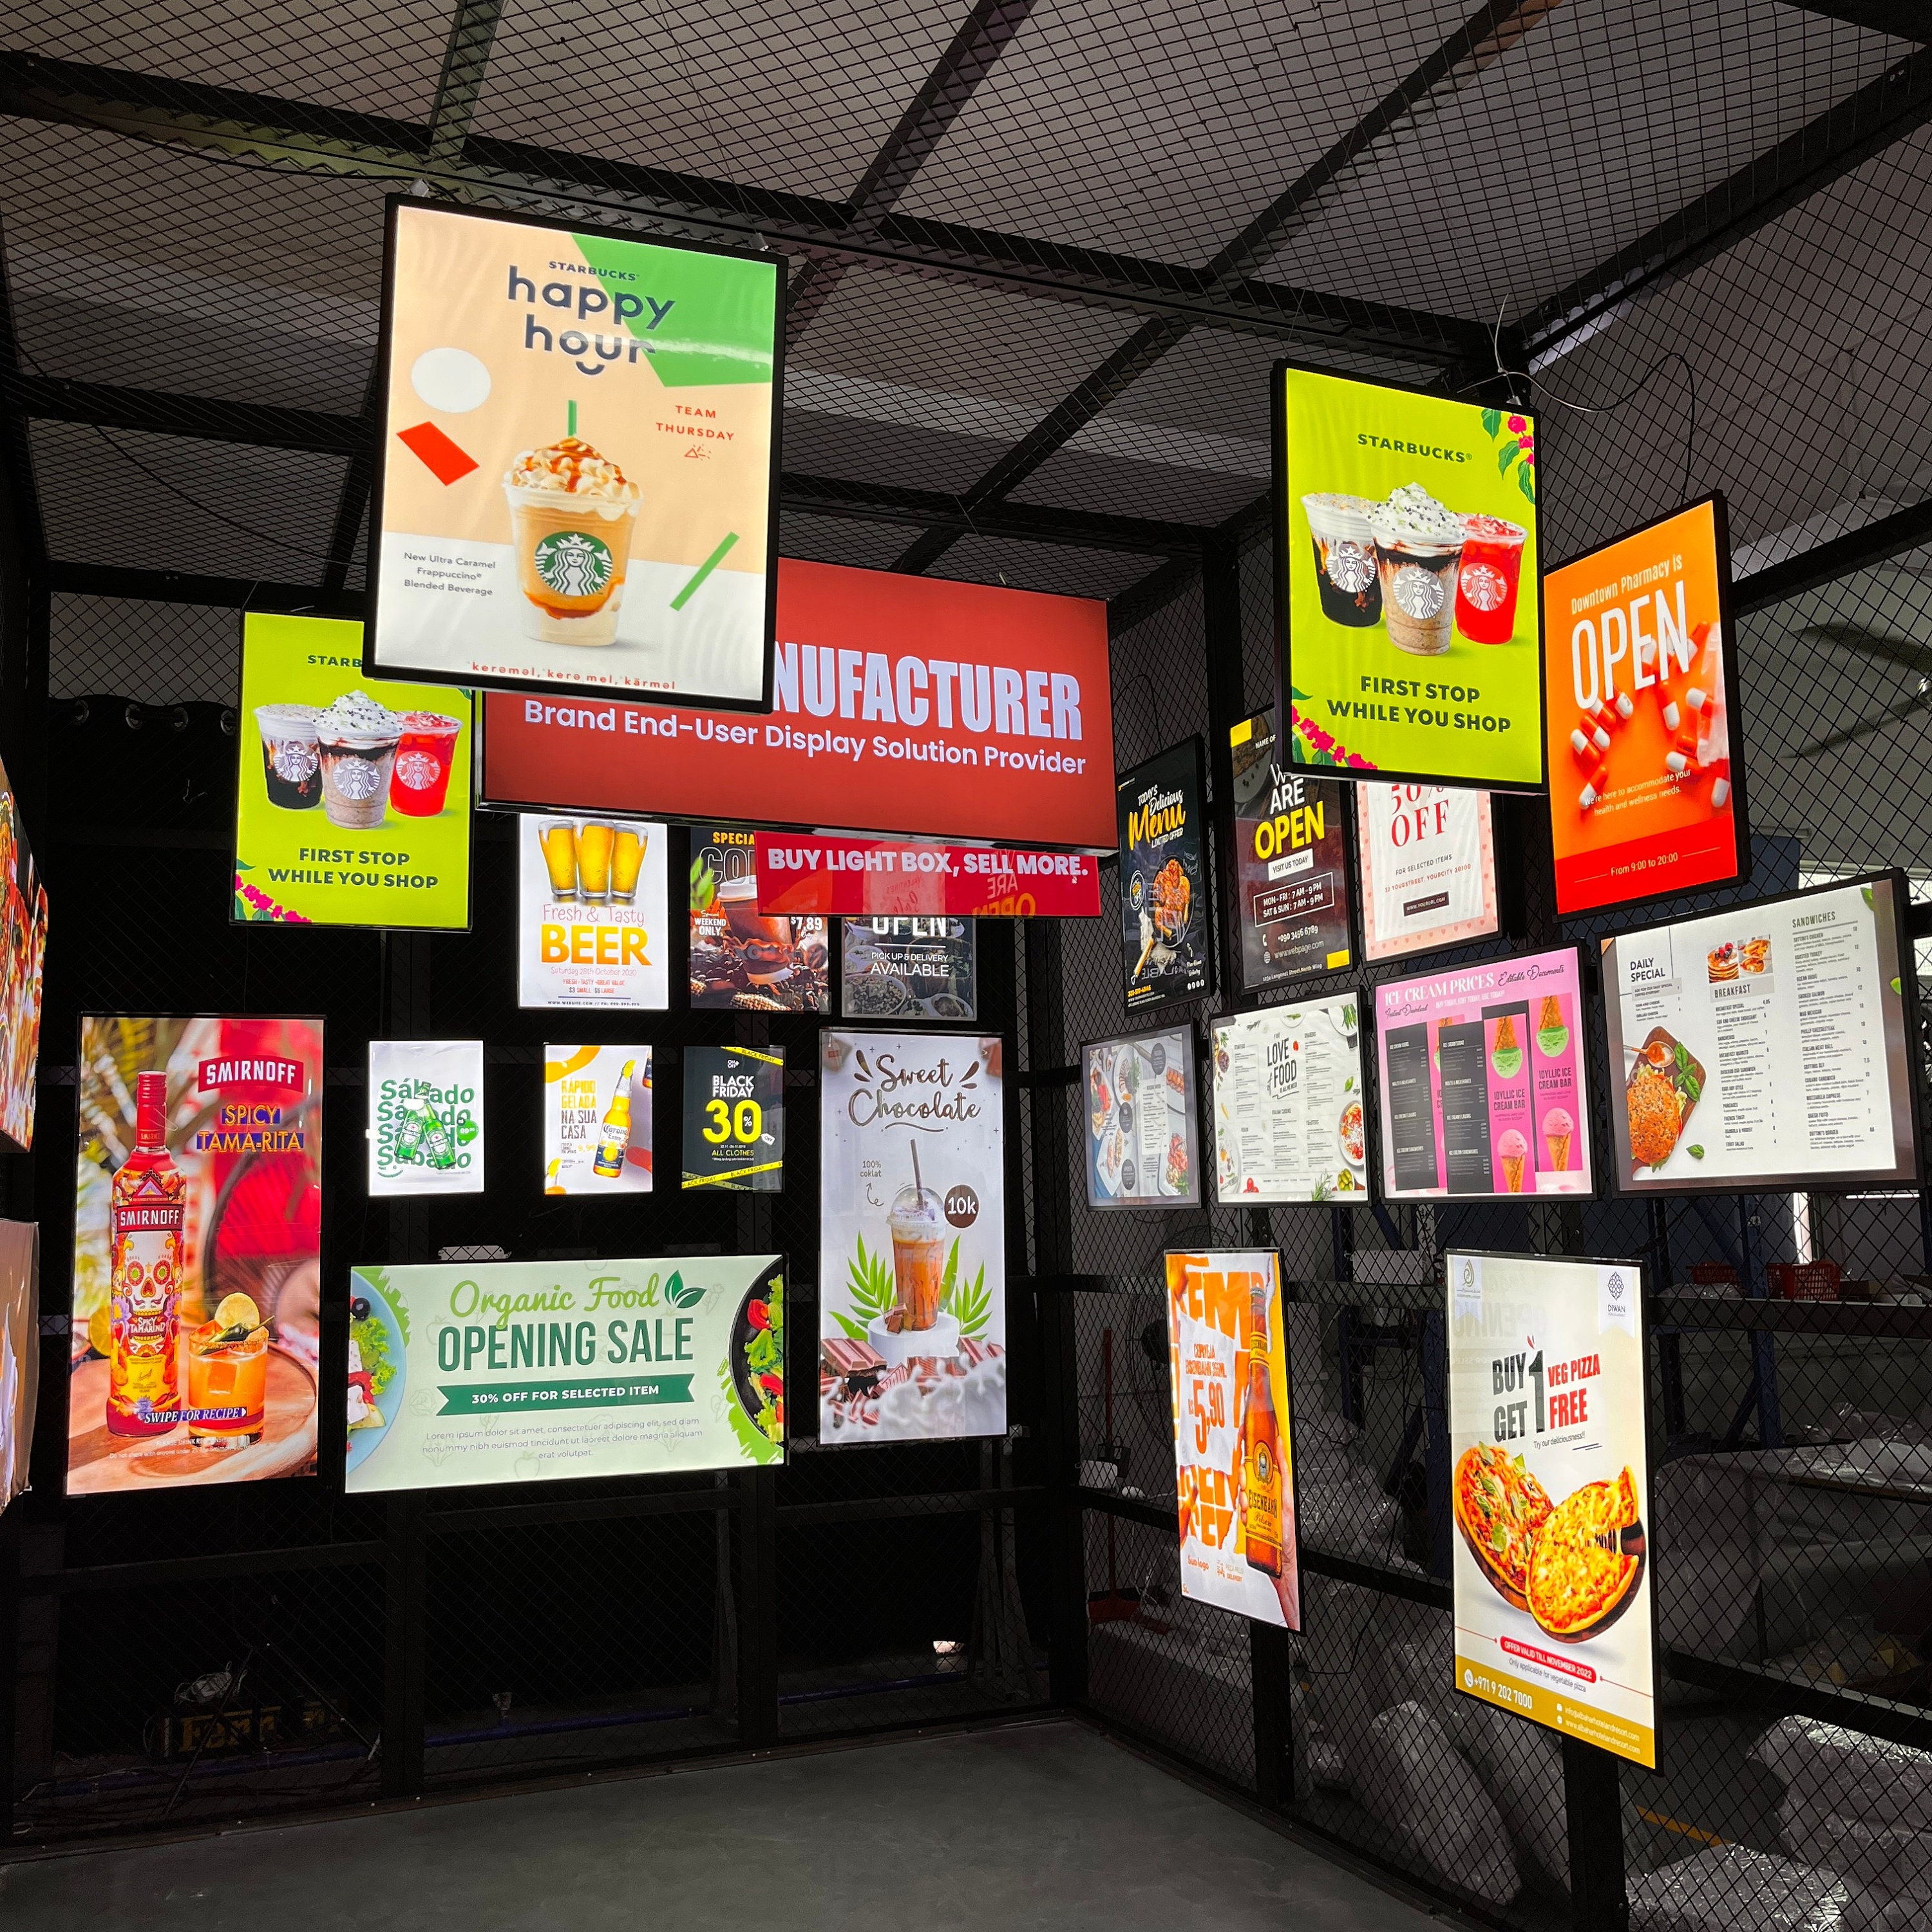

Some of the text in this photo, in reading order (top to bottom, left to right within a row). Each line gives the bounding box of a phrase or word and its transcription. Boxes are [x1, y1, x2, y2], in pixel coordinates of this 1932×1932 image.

[507, 265, 676, 330] happy
[524, 313, 656, 364] hour
[675, 404, 717, 419] TEAM
[656, 421, 735, 442] THURSDAY
[404, 551, 497, 570] New Ultra Caramel
[404, 579, 493, 597] Blended Beverage
[1571, 554, 1683, 615] Downtown Pharmacy is
[1571, 580, 1690, 710] OPEN
[1360, 674, 1481, 704] FIRST STOP
[1327, 699, 1511, 734] WHILE YOU SHOP
[524, 699, 1086, 775] Brand End-User Display Solution Provider
[1255, 737, 1269, 750] NAME
[1626, 768, 1692, 794] accommodate your
[1148, 789, 1184, 817] Delicious
[1269, 777, 1305, 815] ARE
[1593, 793, 1658, 817] health wellness
[1128, 803, 1186, 851] Menu
[1255, 800, 1325, 861] OPEN
[1391, 799, 1450, 848] OFF
[299, 847, 411, 866] FIRST STOP
[768, 848, 1088, 878] BUY LIGHT BOX, SELL MORE.
[1273, 855, 1309, 873] VISIT TODAY
[1407, 853, 1454, 872] SELECTED ITEMS
[1611, 851, 1679, 876] From 9:00 20:00
[267, 867, 439, 889] WHILE YOU SHOP
[542, 904, 645, 927] Fresh & Tasty
[694, 917, 726, 927] WEEKEND
[1792, 911, 1835, 928] SANDWICHES
[698, 926, 722, 936] ONLY
[541, 923, 653, 967] BEER
[871, 952, 949, 962] PICK DELIVERY
[1630, 957, 1654, 971] DAILY
[551, 966, 579, 977] Saturday
[870, 962, 950, 977] AVAILABLE
[1631, 967, 1666, 983] SPECIAL
[1385, 990, 1403, 1007] ICE
[1405, 981, 1448, 1003] CREAM
[1450, 972, 1495, 994] PRICES
[1714, 984, 1751, 999] BREAKFAST
[1267, 1037, 1290, 1067] LOVE
[206, 1060, 296, 1084] SMIRNOFF
[712, 1075, 755, 1086] BLACK
[875, 1054, 953, 1092] Sweet
[1273, 1059, 1297, 1088] FOOD
[1539, 1066, 1572, 1079] IDYLLIC ICE
[1539, 1077, 1572, 1090] CREAM BAR
[712, 1086, 755, 1097] FRIDAY
[1494, 1088, 1526, 1101] IDYLLIC ICE
[225, 1104, 279, 1126] SPICY
[848, 1087, 982, 1127] Chocolate
[1493, 1099, 1526, 1111] CREAM BAR
[561, 1110, 597, 1124] NA SUA
[702, 1099, 762, 1144] 30
[198, 1130, 302, 1153] TAMA-RITA
[561, 1125, 587, 1139] CASA
[860, 1170, 882, 1178] coklat
[862, 1160, 882, 1169] 100%
[947, 1196, 977, 1216] 10k
[120, 1209, 180, 1227] SMIRNOFF
[450, 1272, 660, 1331] Organic Food
[129, 1322, 166, 1333] TAMARIND
[137, 1316, 157, 1327] SPICY
[438, 1316, 694, 1372] OPENING SALE
[471, 1384, 659, 1404] 30% OFF FOR SELECTED ITEM
[1492, 1349, 1602, 1434] BUY 1 VEG PIZZA
[144, 1407, 240, 1425] SWIPE FOR RECIPE
[1193, 1379, 1225, 1455] 5,90
[1494, 1387, 1589, 1443] GET FREE
[426, 1417, 700, 1441] Lorem ipsum dolor consectetuer adipiscing sed diam
[422, 1444, 468, 1454] nonummy
[491, 1440, 529, 1450] euismod
[530, 1437, 569, 1446] tincidunt
[581, 1435, 611, 1444] laoreet
[612, 1434, 639, 1443] dolore
[639, 1431, 669, 1442] magna
[670, 1429, 703, 1440] aliquam
[538, 1451, 555, 1459] erat
[1248, 1489, 1278, 1519] EISENBAHN
[1504, 1640, 1593, 1680] OFFER VALID NOVEMBER 2022
[1508, 1657, 1587, 1693] Only applicable vegetable pizza
[1474, 1676, 1533, 1710] +971 202 7000
